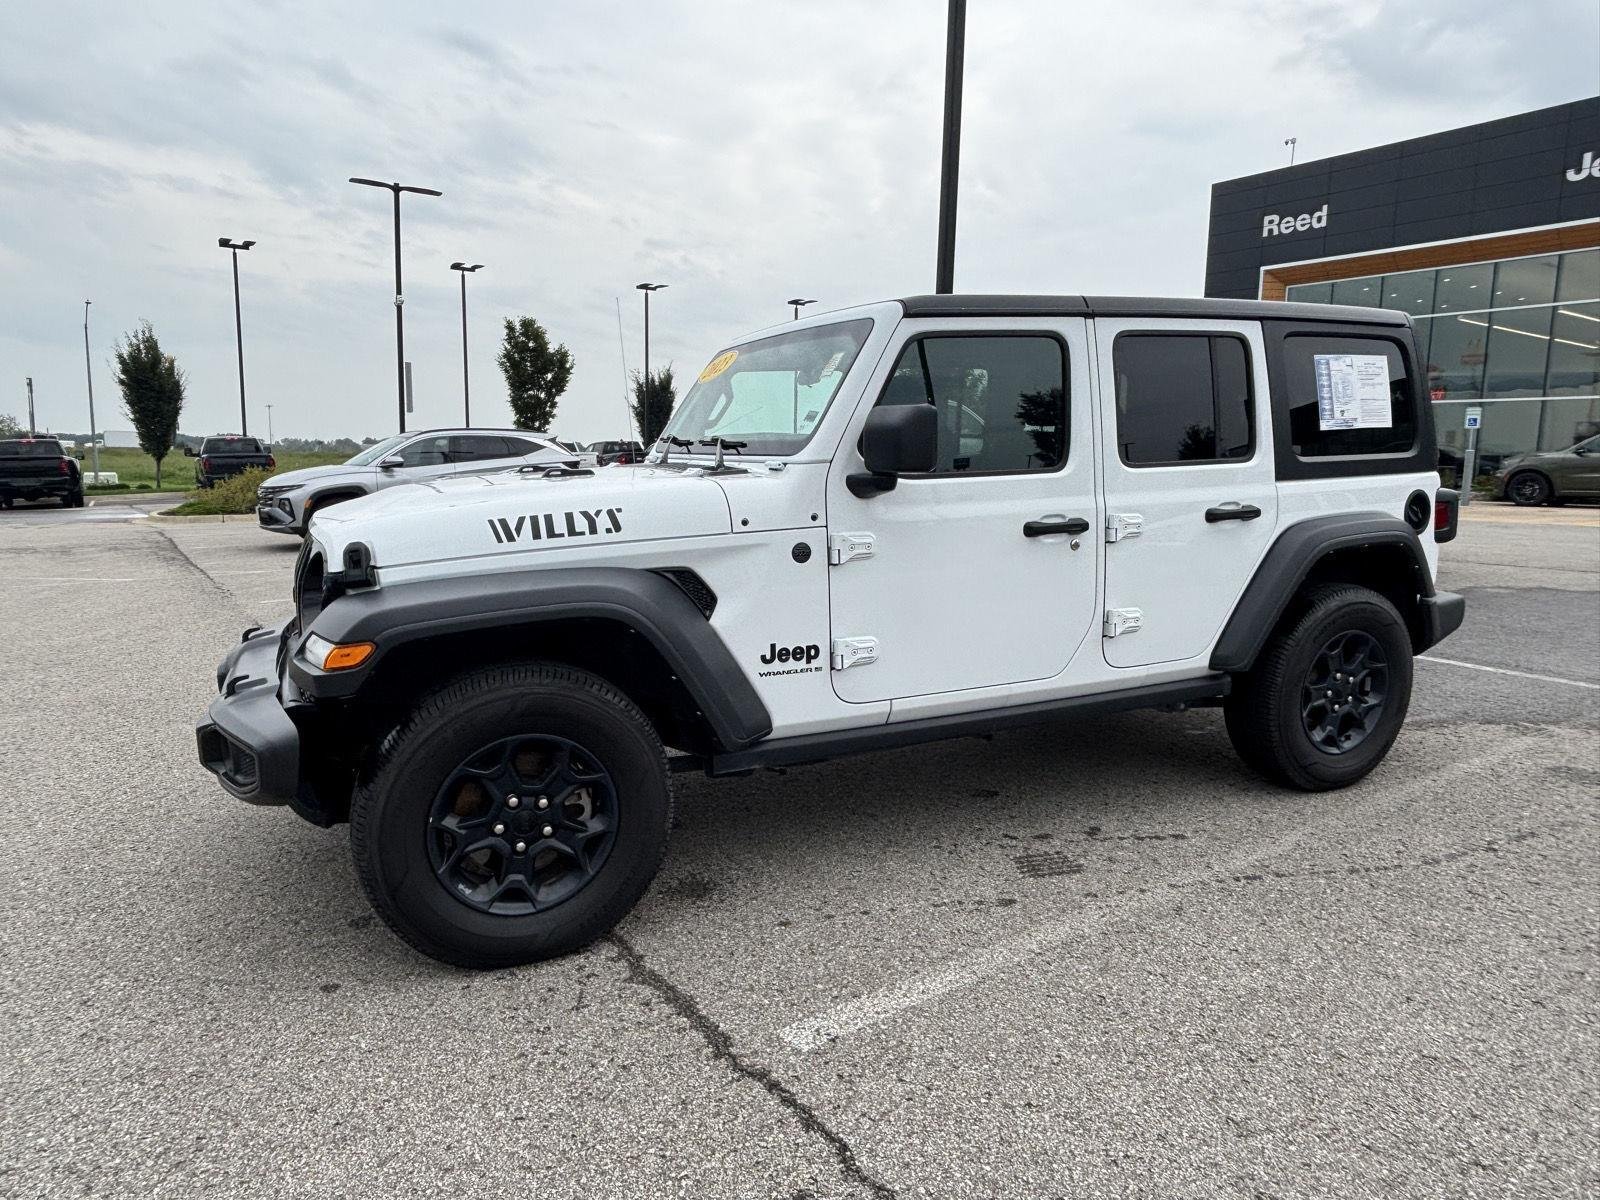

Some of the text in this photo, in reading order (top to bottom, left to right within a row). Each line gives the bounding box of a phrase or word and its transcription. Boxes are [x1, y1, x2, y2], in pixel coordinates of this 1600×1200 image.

[1262, 204, 1328, 237] Reed
[488, 508, 622, 543] WILLYS
[760, 643, 820, 664] Jeep
[758, 667, 813, 677] WRANGLER
